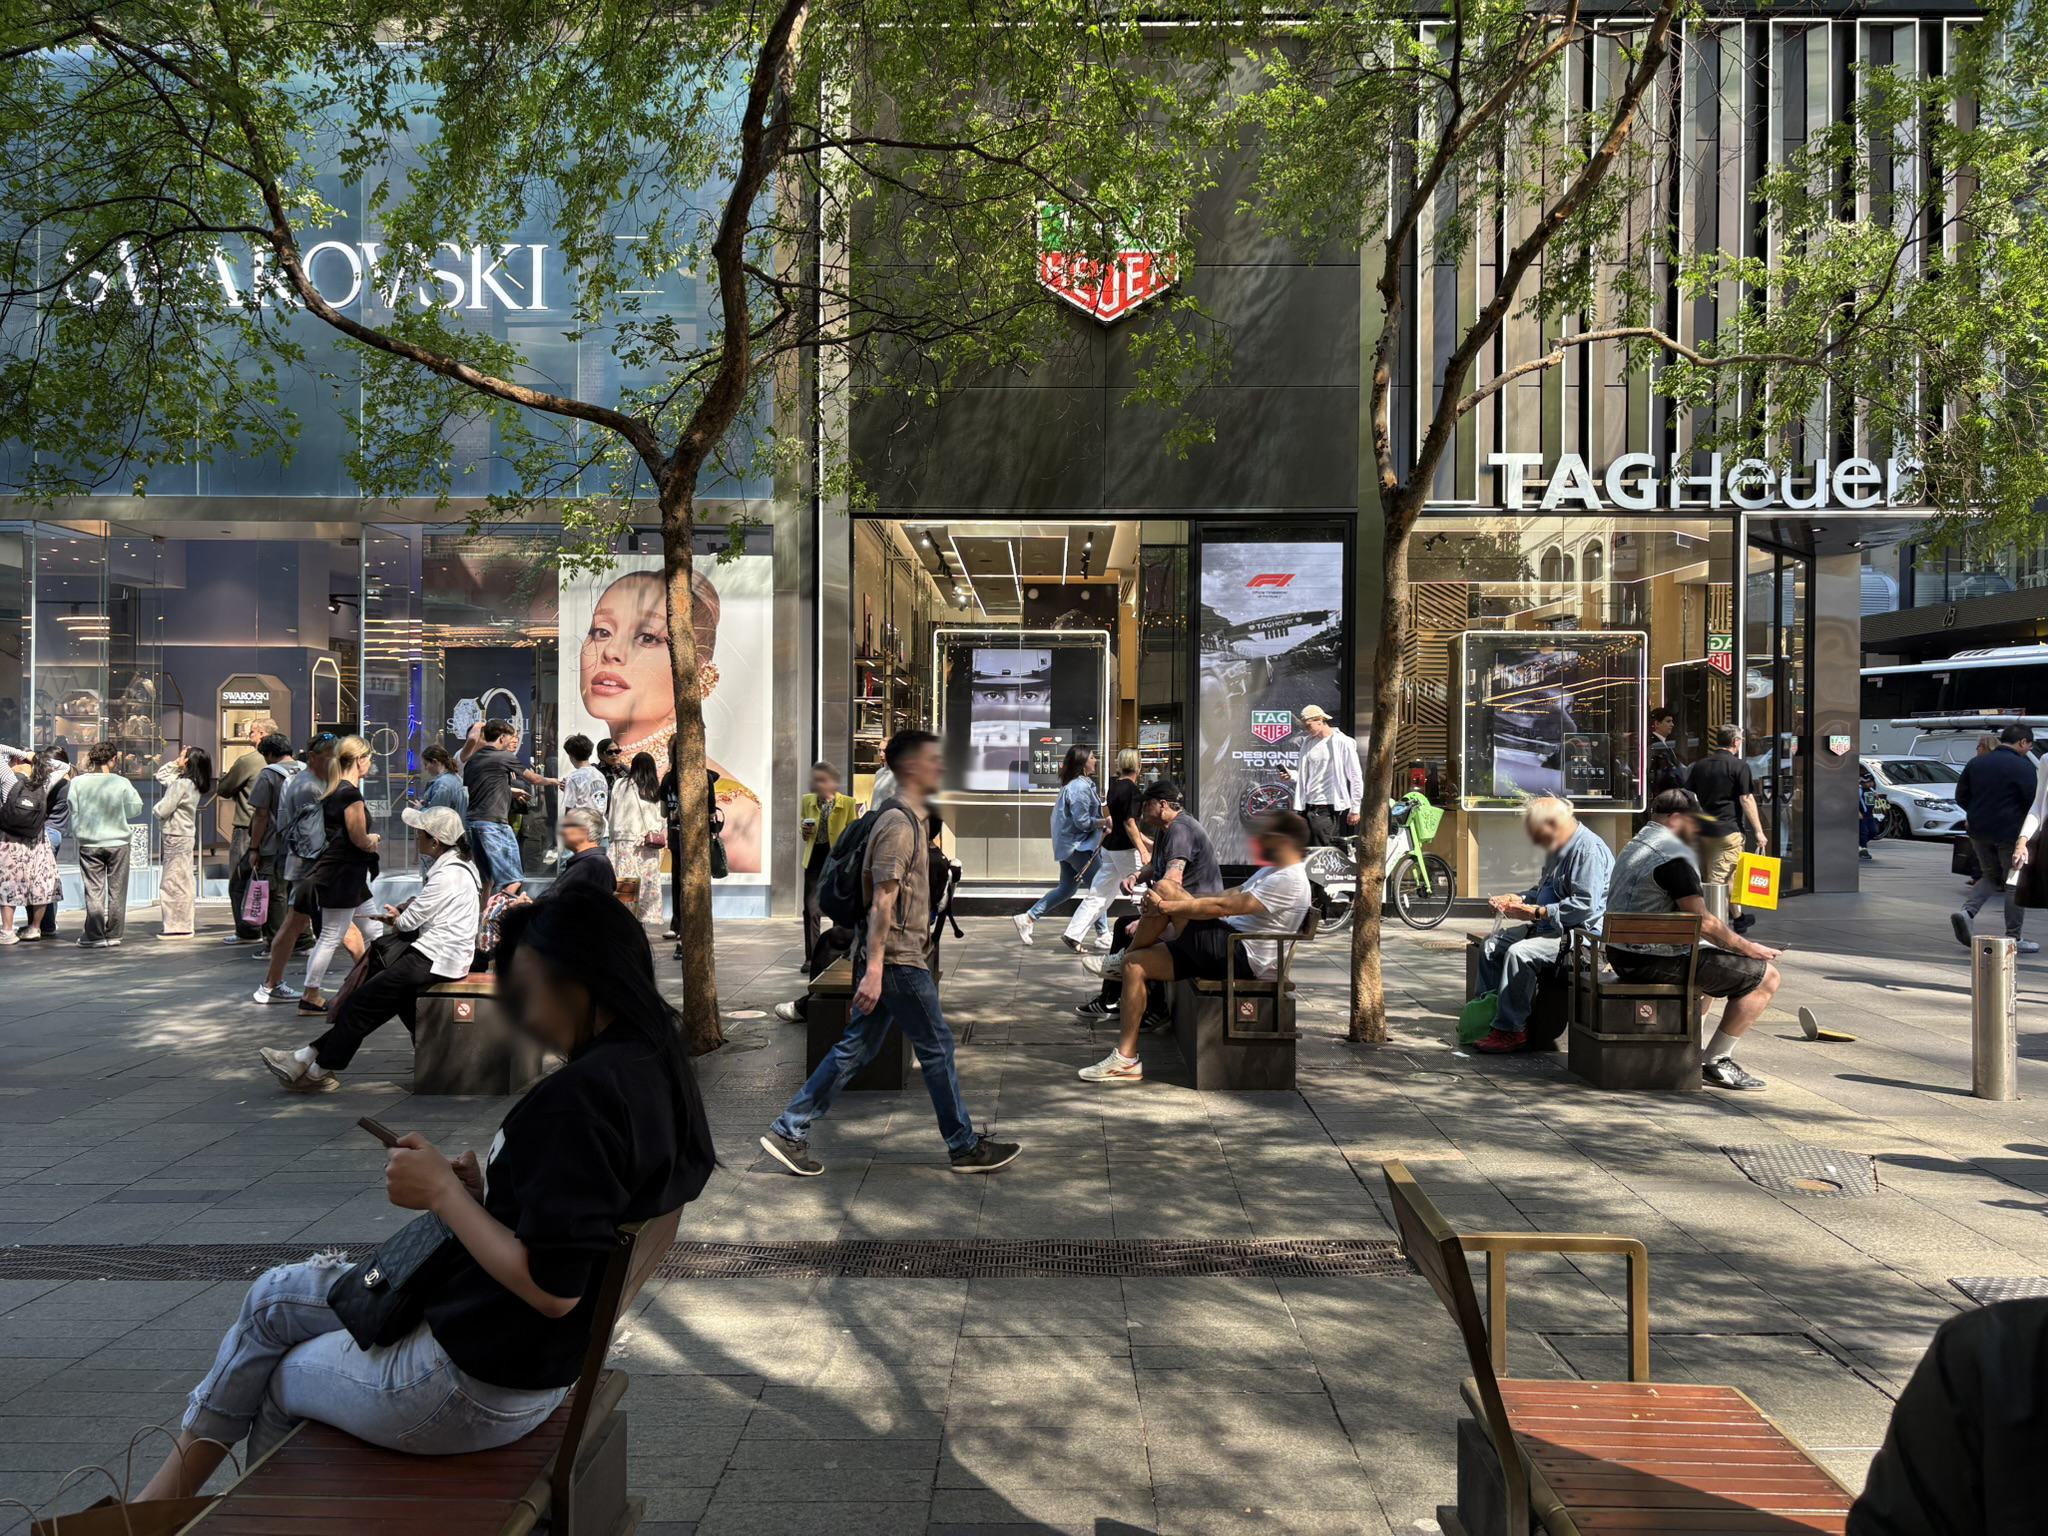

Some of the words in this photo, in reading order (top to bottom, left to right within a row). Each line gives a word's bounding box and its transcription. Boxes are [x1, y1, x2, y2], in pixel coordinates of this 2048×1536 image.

[222, 692, 269, 700] SWAROVSKI
[1255, 712, 1288, 723] TAG
[1254, 725, 1290, 741] HEUER
[1232, 751, 1300, 759] DESIGNE
[1244, 759, 1265, 767] TO
[1750, 875, 1769, 888] LEGO
